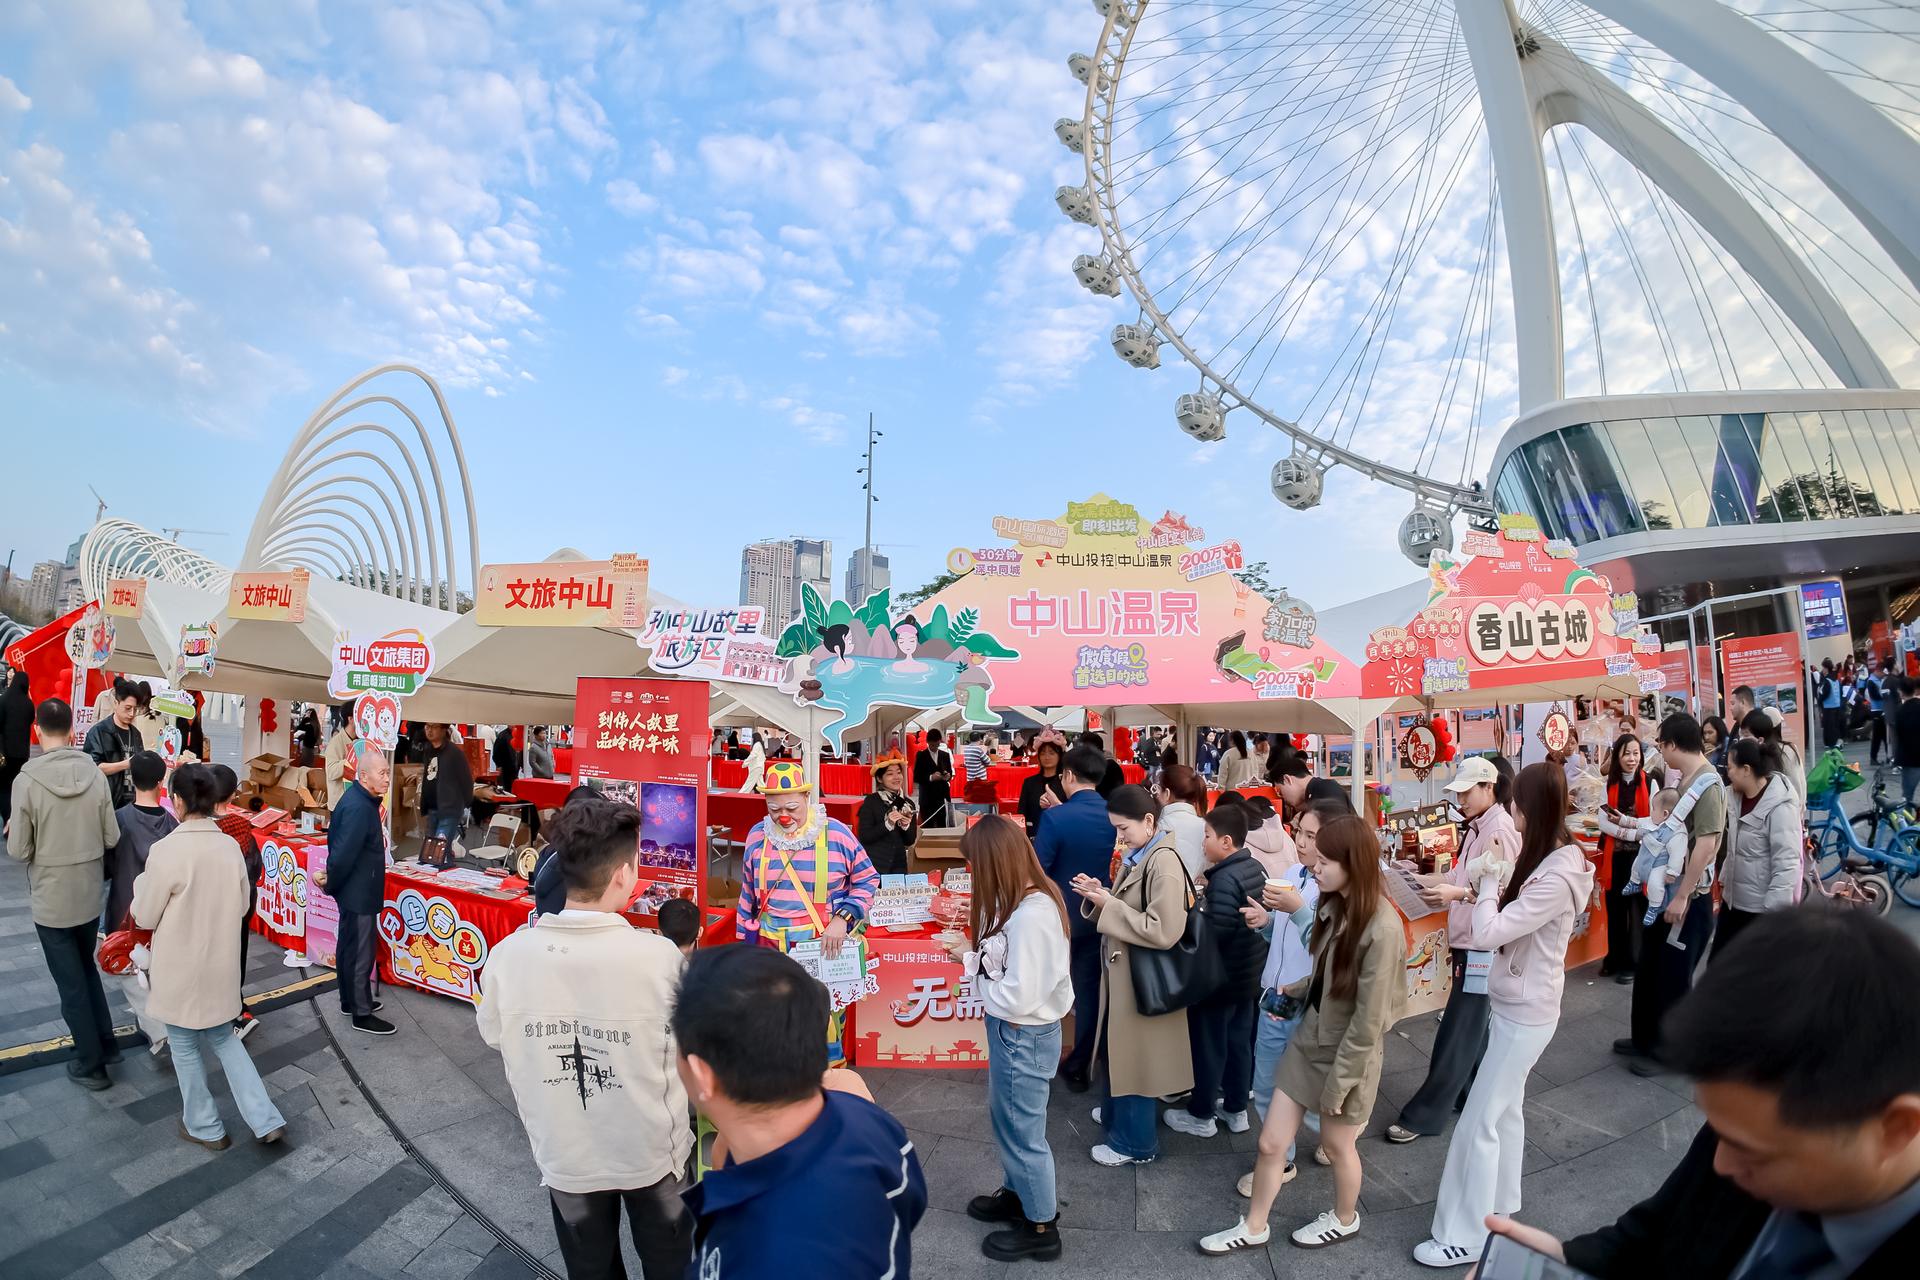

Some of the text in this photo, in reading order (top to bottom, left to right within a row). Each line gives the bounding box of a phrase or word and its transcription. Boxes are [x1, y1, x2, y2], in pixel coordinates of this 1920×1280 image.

[1082, 519, 1137, 533] 即刻出发
[979, 550, 1017, 561] 30分钟
[1056, 553, 1172, 567] 中山投控 中山温泉
[1180, 545, 1222, 572] 200万
[975, 564, 1021, 576] 深中同城
[111, 588, 138, 608] 文旅中山
[241, 584, 292, 608] 文旅中山
[504, 576, 614, 610] 文旅中山
[643, 609, 760, 638] 孙中山故里
[1008, 590, 1200, 636] 中山温泉
[1264, 608, 1316, 634] 家门口的
[1264, 626, 1313, 649] 真温泉
[1476, 609, 1588, 651] 香山古城
[339, 644, 427, 670] 中山文旅集团
[655, 634, 725, 664] 旅游区
[1080, 646, 1130, 668] 微度假
[352, 673, 406, 689] 带您畅游中山
[1075, 667, 1147, 687] 首选目的地
[1253, 672, 1298, 688] 200万
[1423, 676, 1469, 693] 首选目的地
[597, 710, 680, 733] 到伟人故里
[596, 731, 680, 755] 品岭南年味
[883, 953, 927, 964] 中山投控
